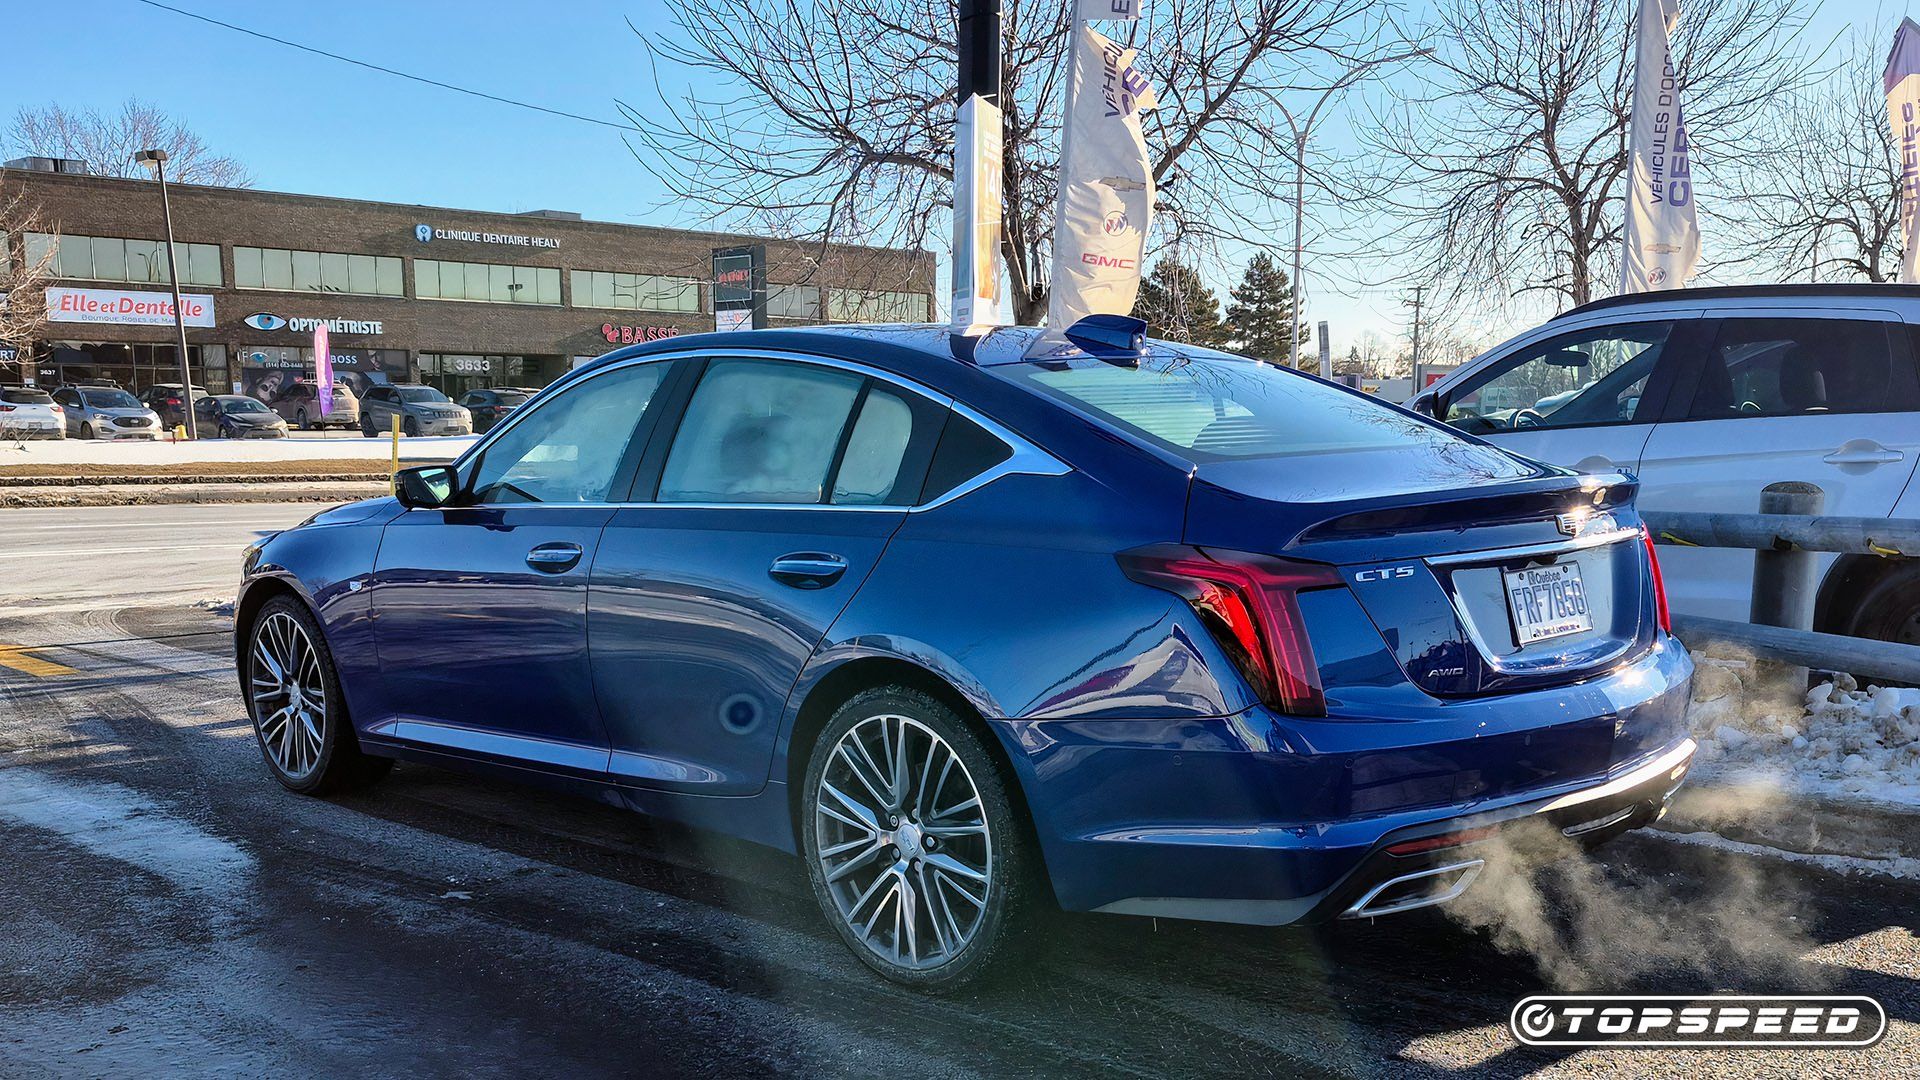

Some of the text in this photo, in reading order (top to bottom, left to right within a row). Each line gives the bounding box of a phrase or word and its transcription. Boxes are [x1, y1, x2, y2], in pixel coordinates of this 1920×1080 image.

[1649, 112, 1670, 204] VÉHICULES
[435, 229, 561, 249] CLINIQUE DENTAIRE HEALY
[1081, 253, 1135, 269] GMC
[60, 294, 98, 312] Elle
[100, 302, 115, 313] et
[455, 359, 491, 371] 3633
